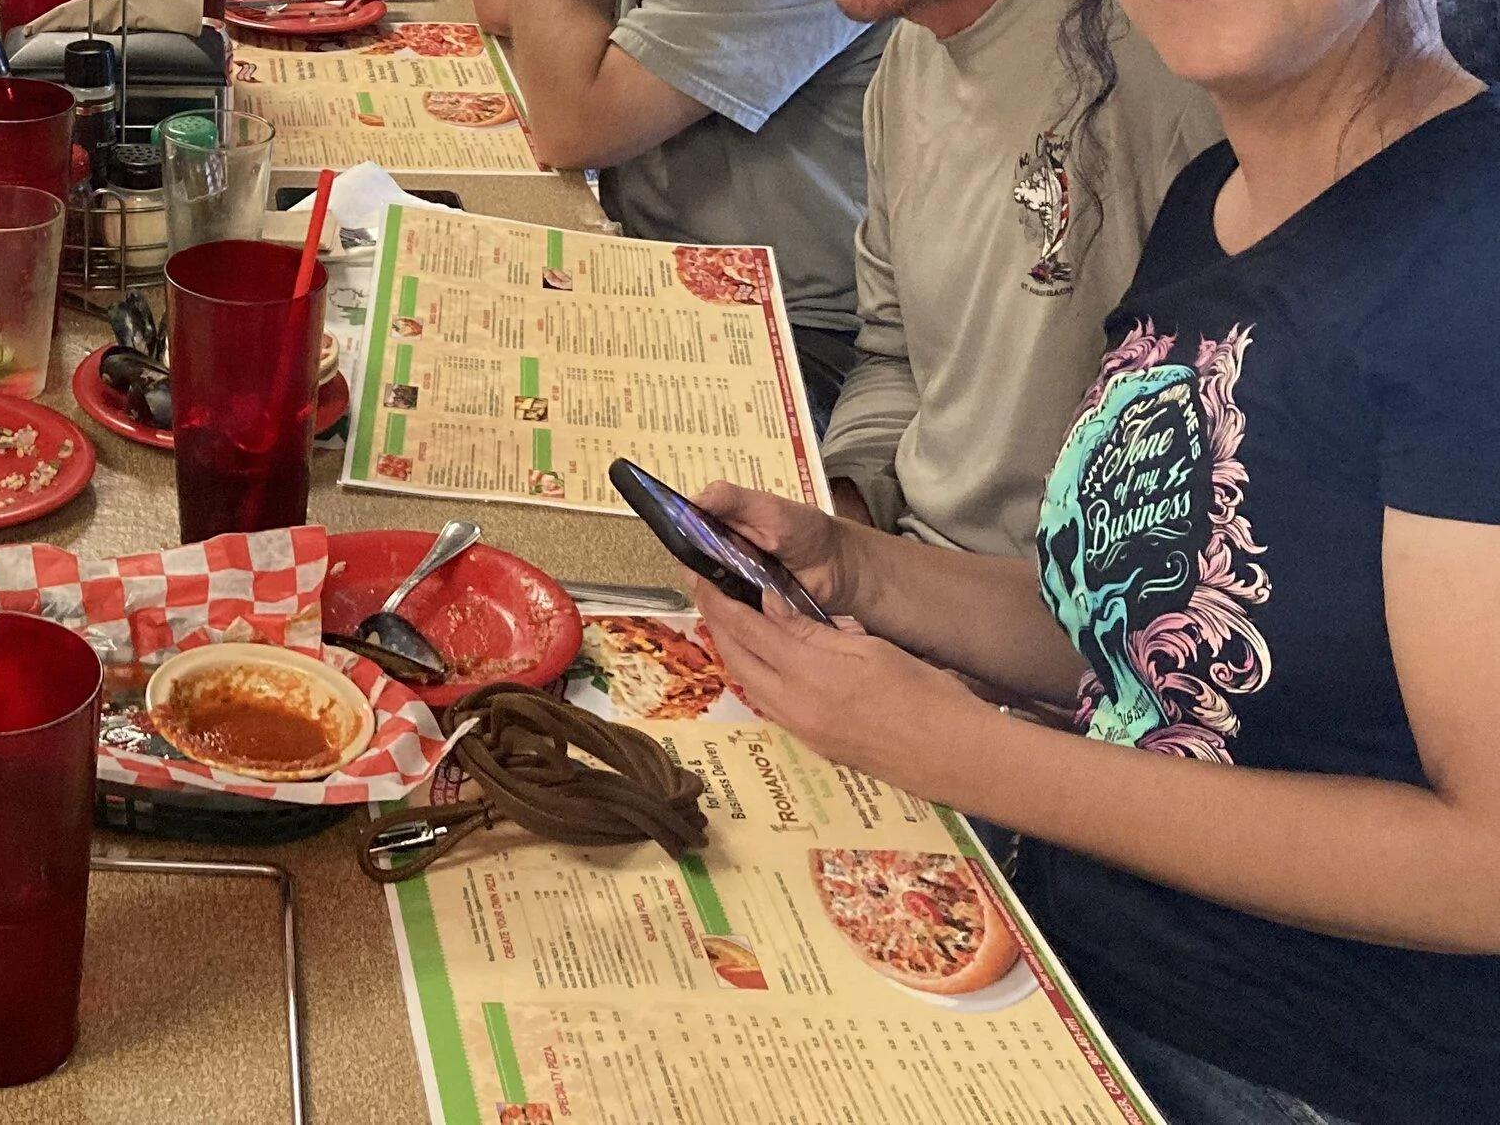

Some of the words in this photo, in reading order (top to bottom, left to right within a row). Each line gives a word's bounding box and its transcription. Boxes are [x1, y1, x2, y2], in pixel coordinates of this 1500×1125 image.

[1113, 466, 1136, 507] of
[1133, 467, 1161, 496] my
[1085, 490, 1192, 563] Business
[702, 739, 728, 777] Delivery
[748, 743, 800, 824] ROMANO'S
[705, 793, 721, 811] for
[718, 778, 747, 821] Business
[484, 873, 497, 892] PIZZA
[489, 893, 502, 910] OWN
[632, 893, 647, 913] PIZZA
[493, 910, 508, 931] YOUR
[499, 930, 516, 959] CREATE
[543, 1045, 559, 1069] PIZZA
[550, 1070, 572, 1117] SPECIALTY
